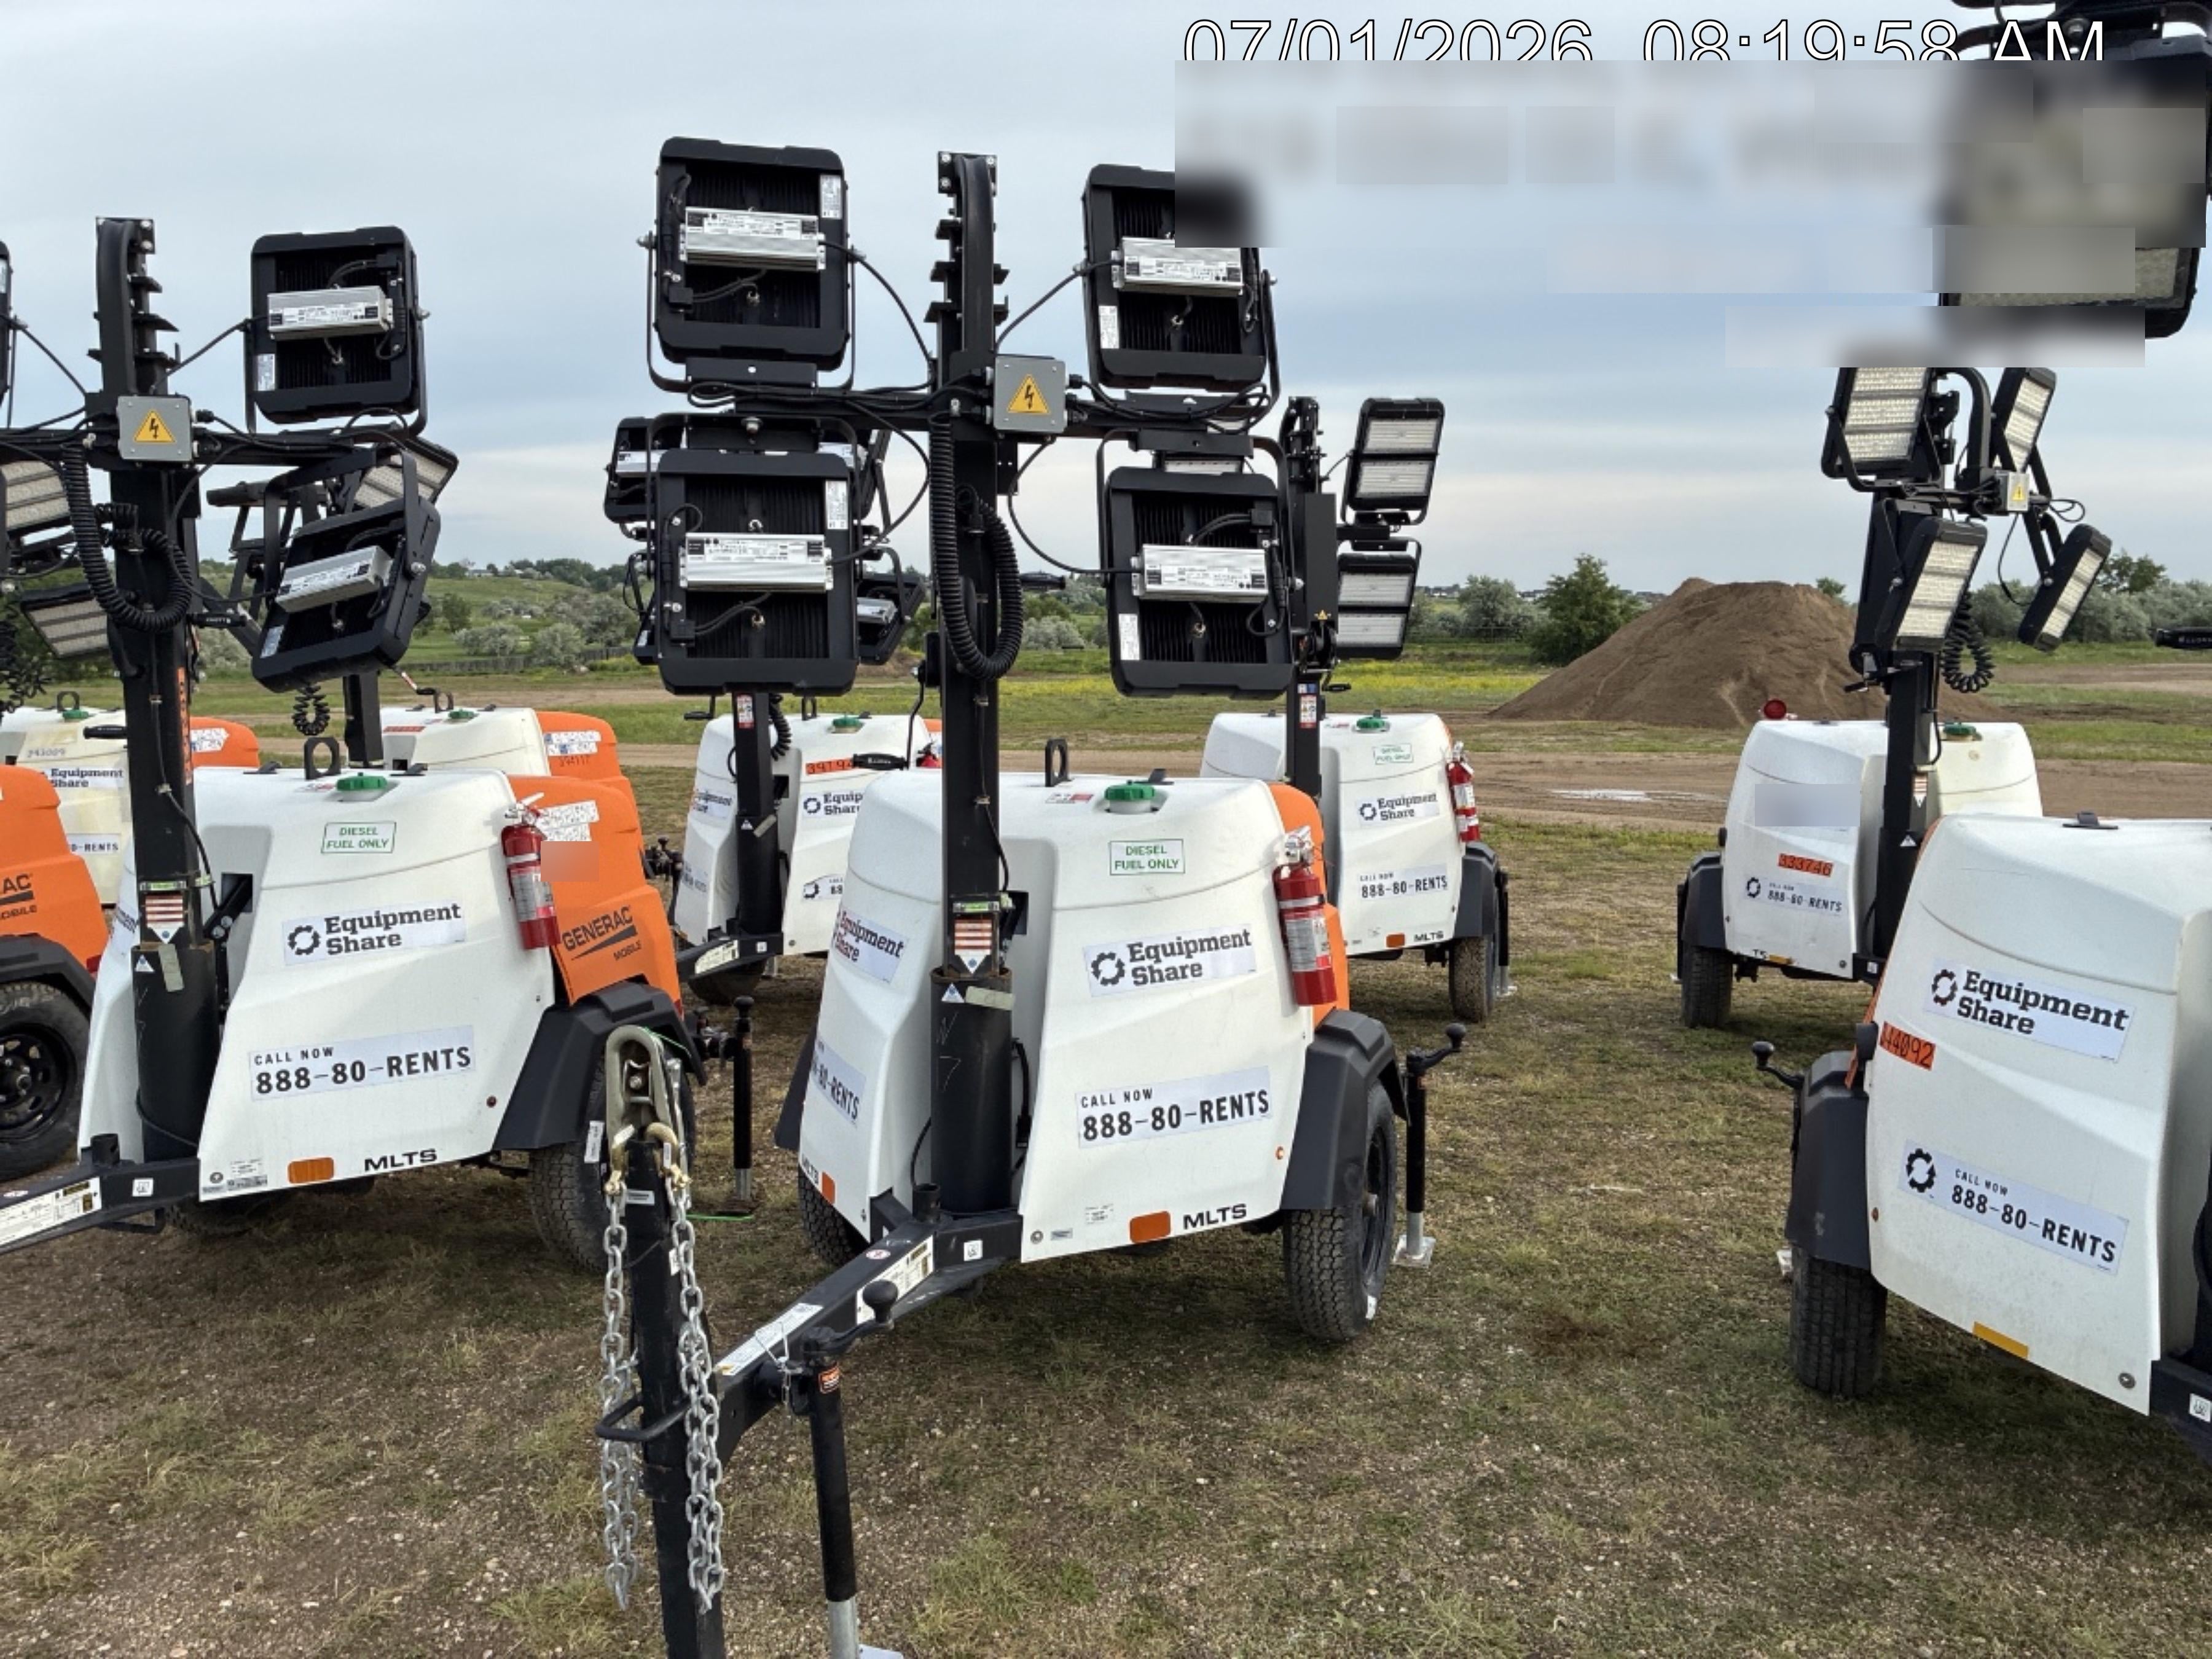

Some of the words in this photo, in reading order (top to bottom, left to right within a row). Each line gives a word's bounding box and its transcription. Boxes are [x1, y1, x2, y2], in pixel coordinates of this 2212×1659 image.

[50, 768, 124, 778] Equipment
[823, 790, 863, 804] Equip
[1377, 793, 1438, 810] Equipment
[1379, 809, 1415, 821] Share
[339, 826, 378, 836] DIESEL
[326, 839, 355, 849] FUEL
[358, 839, 390, 849] ONLY
[1126, 845, 1167, 856] DIESEL
[1114, 860, 1145, 871] FUEL
[1148, 858, 1180, 869] ONLY
[1361, 875, 1448, 898] 888-80-RENTS
[1767, 890, 1843, 912] 888-80-RENTS
[324, 903, 461, 935] Equipment
[562, 906, 633, 951] GENERAC
[325, 933, 402, 955] Share
[613, 939, 642, 961] MOBILE
[1126, 928, 1252, 964] Equipment
[1131, 962, 1203, 987] Share
[1963, 970, 2130, 1031] Equipment
[1956, 996, 2036, 1035] Share
[254, 1051, 292, 1066] CALL
[300, 1046, 334, 1061] NOW
[256, 1046, 471, 1094] 888-80-RENTS
[1081, 1092, 1116, 1108] CALL
[1123, 1087, 1153, 1103] NOW
[1083, 1089, 1269, 1141] 888-80-RENTS
[364, 1148, 437, 1172] MLTS
[1955, 1168, 1980, 1186] CALL
[1985, 1179, 2009, 1197] NOW
[1183, 1203, 1247, 1230] MLTS
[1951, 1184, 2117, 1263] 888-80-RENTS
